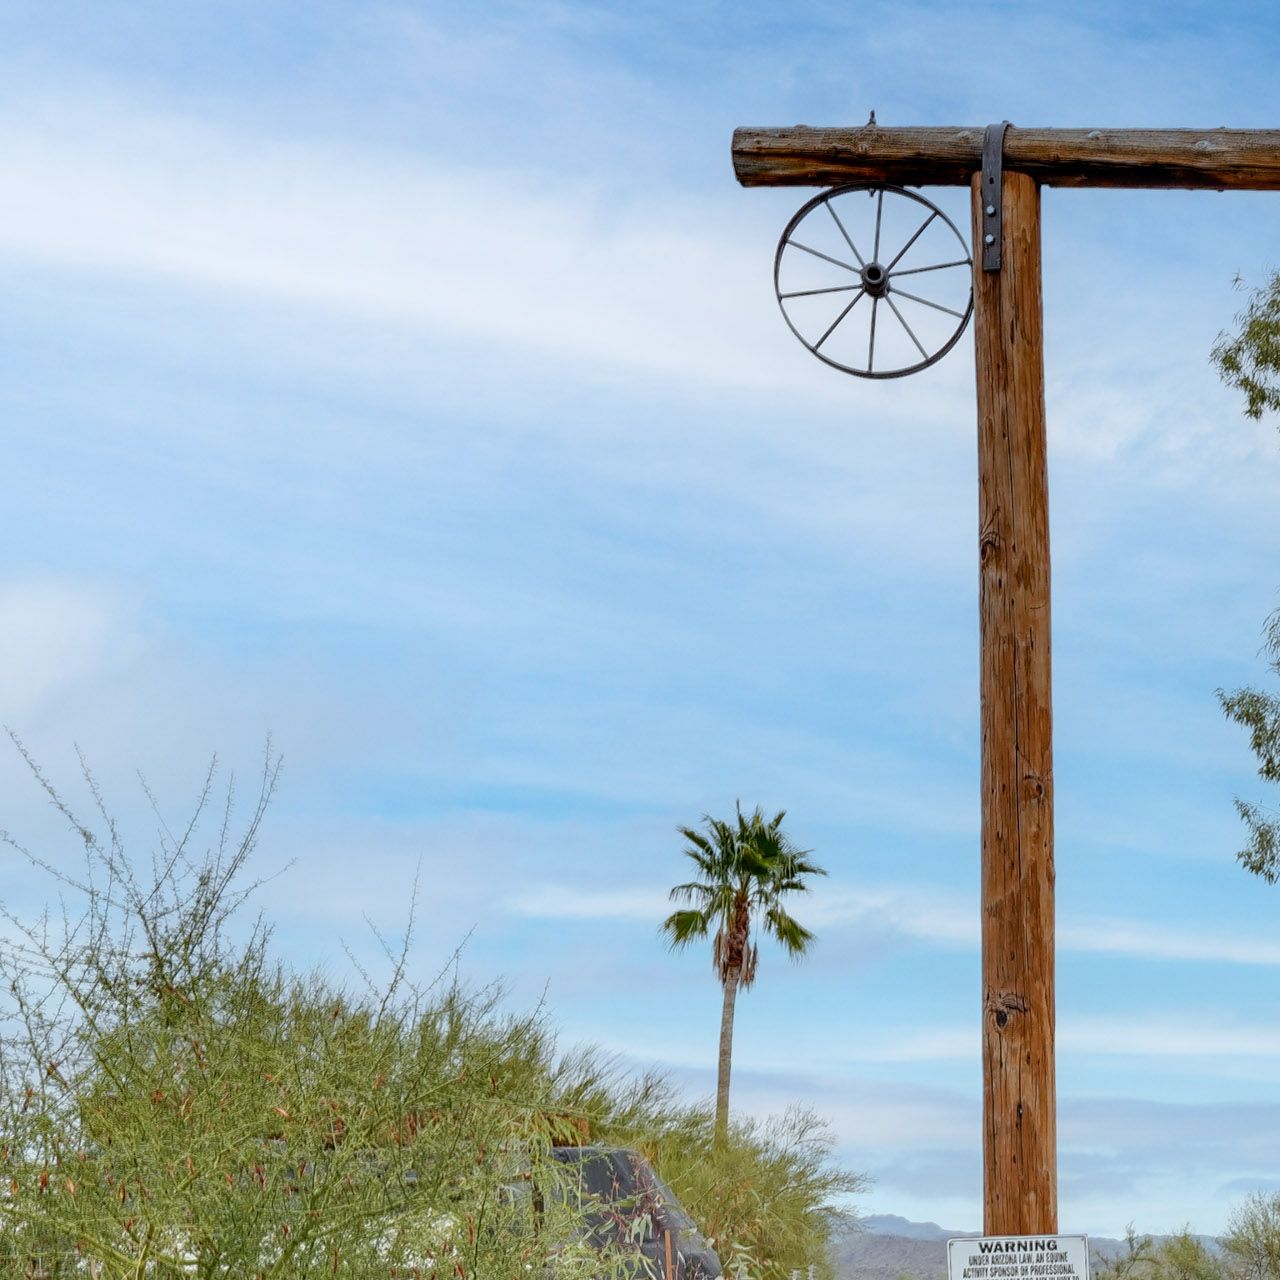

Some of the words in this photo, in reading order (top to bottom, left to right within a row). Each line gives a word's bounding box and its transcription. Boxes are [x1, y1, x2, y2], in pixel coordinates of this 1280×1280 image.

[979, 1240, 1057, 1253] WARNING
[969, 1254, 989, 1266] UNDER
[991, 1253, 1017, 1265] ARIZONA
[1036, 1252, 1045, 1263] AN
[1046, 1251, 1068, 1264] EQUINE
[963, 1267, 988, 1278] ACTIVITY
[990, 1266, 1018, 1277] SPONSOR
[1020, 1266, 1029, 1276] OR
[1030, 1264, 1075, 1276] PROFESSIONAL
